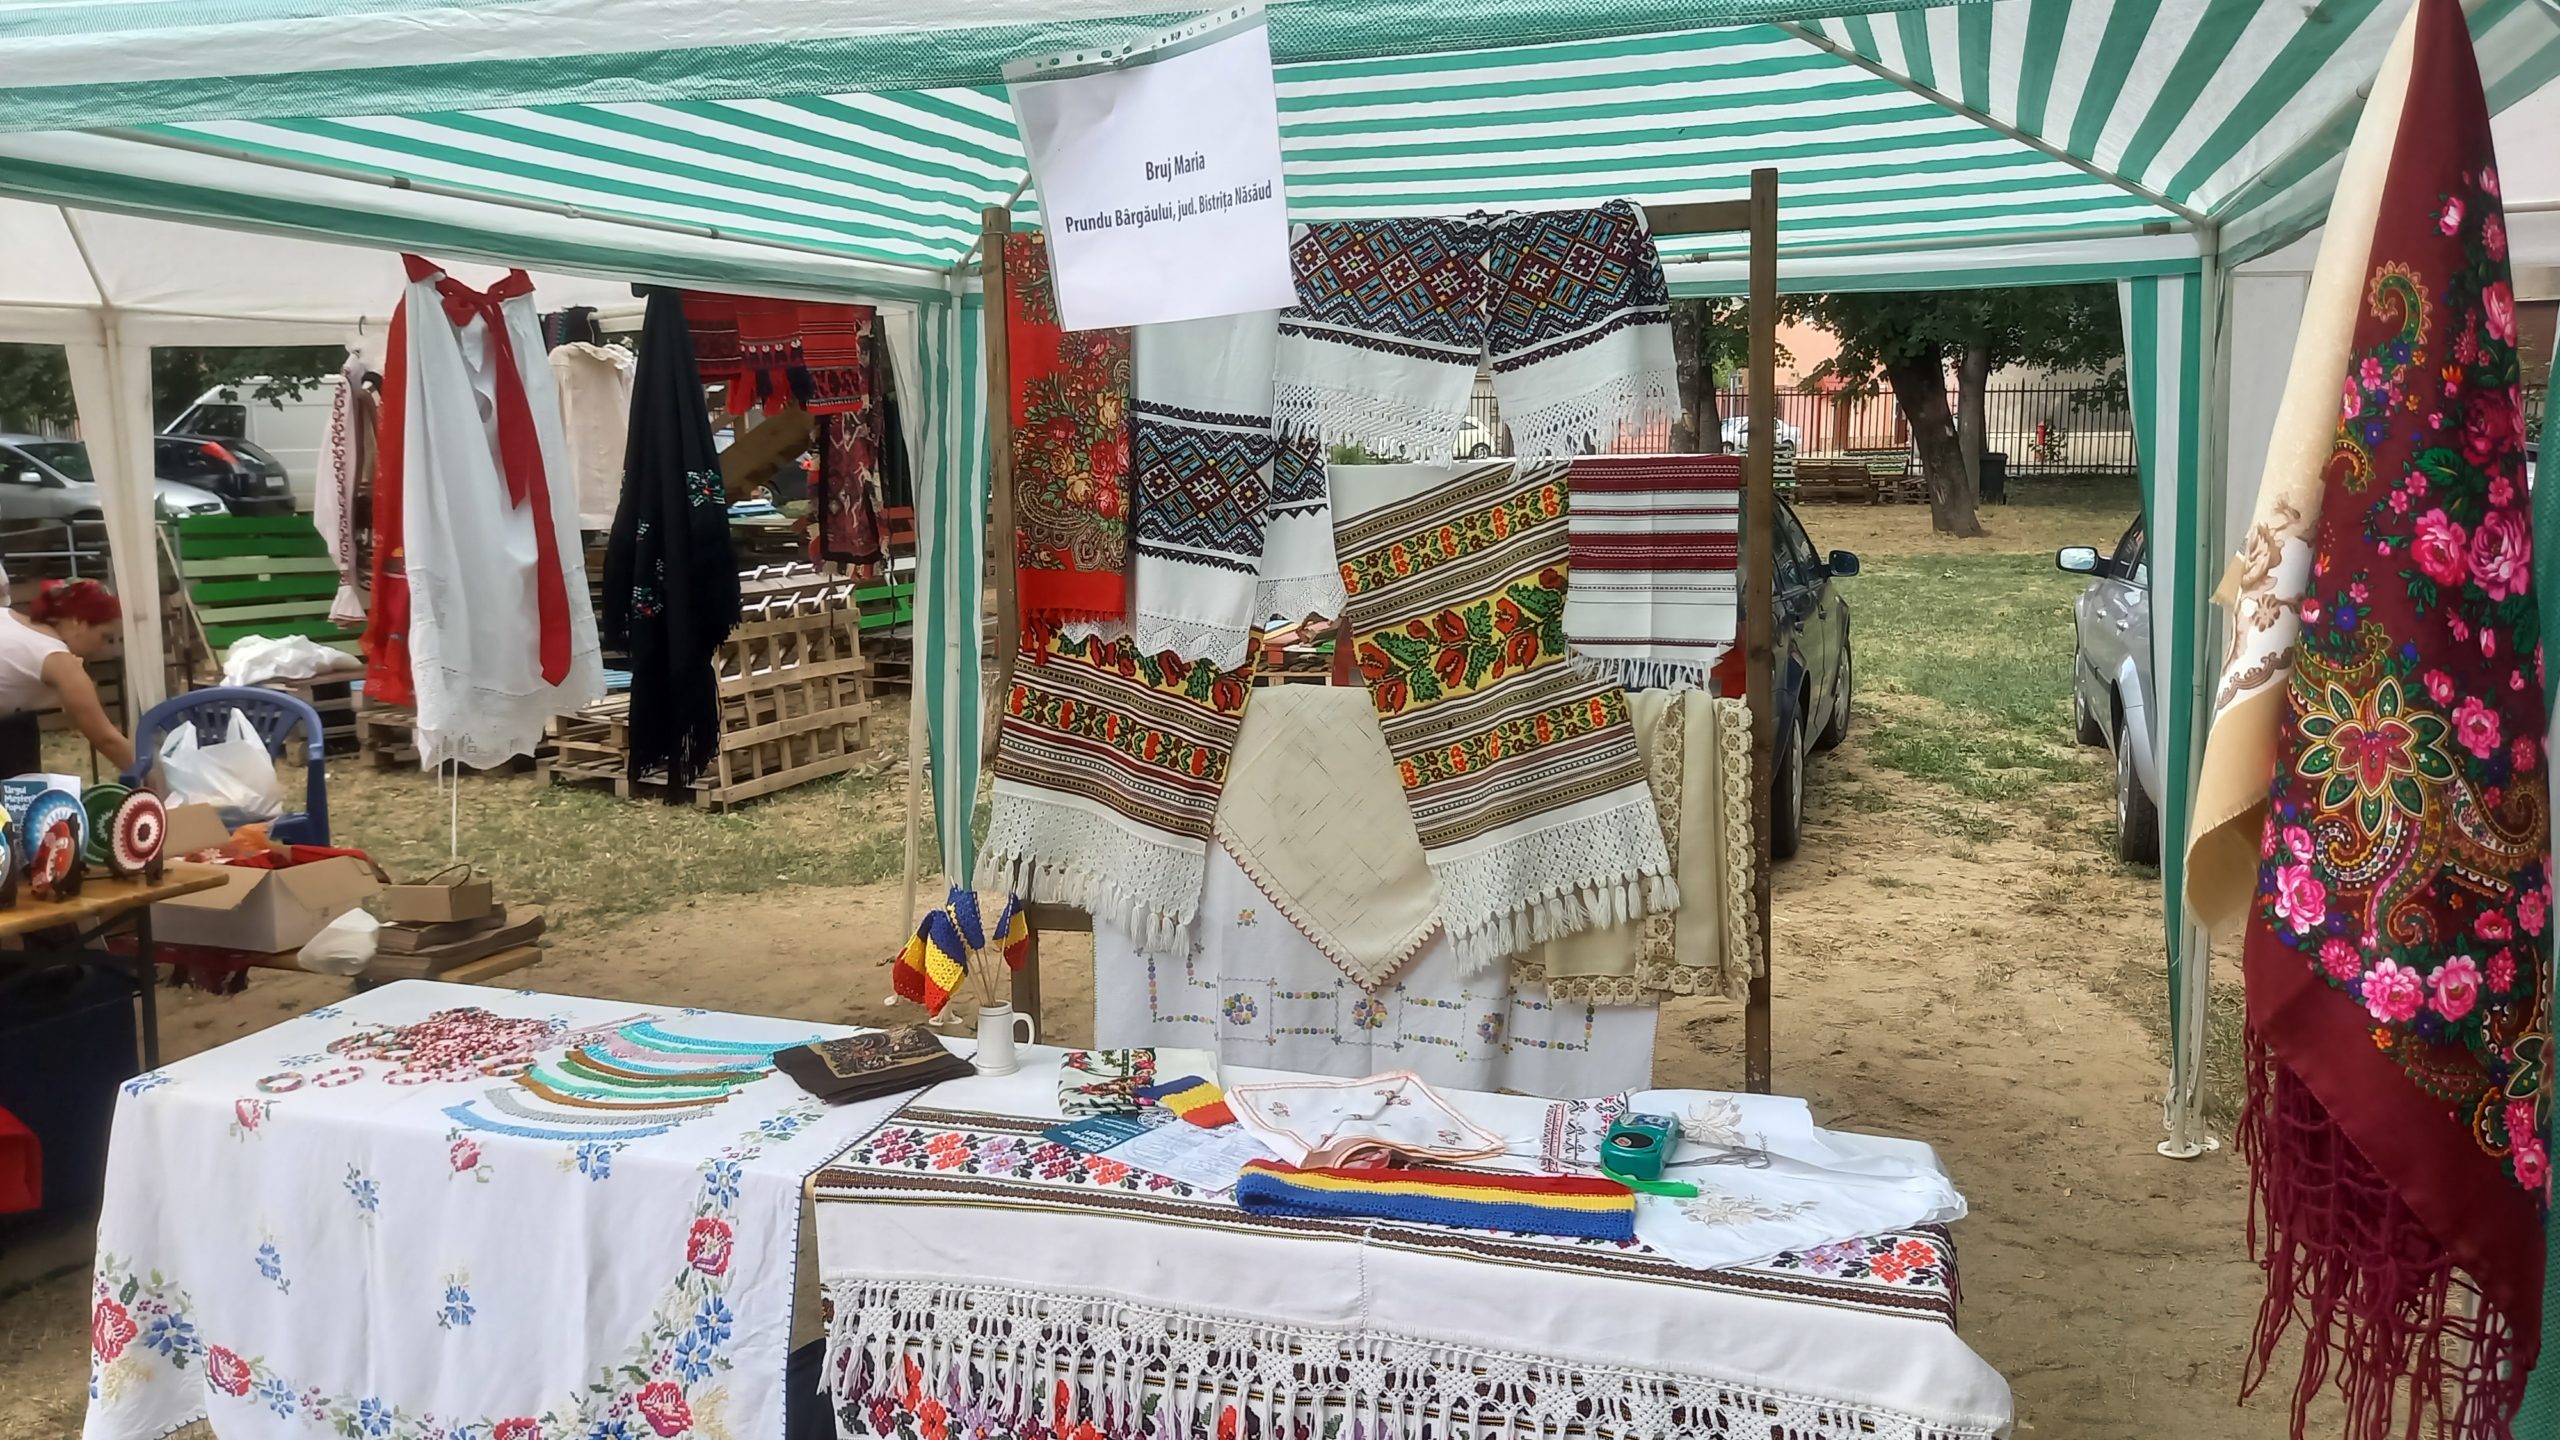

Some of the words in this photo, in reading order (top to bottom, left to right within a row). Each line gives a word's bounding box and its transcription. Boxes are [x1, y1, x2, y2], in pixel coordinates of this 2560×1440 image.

[1145, 157, 1172, 182] Bruj
[1174, 151, 1205, 175] Maria
[1065, 211, 1112, 233] Prundu
[1114, 202, 1176, 229] Bârgăului,
[1178, 197, 1197, 222] jud.
[1235, 179, 1272, 205] Năsăud
